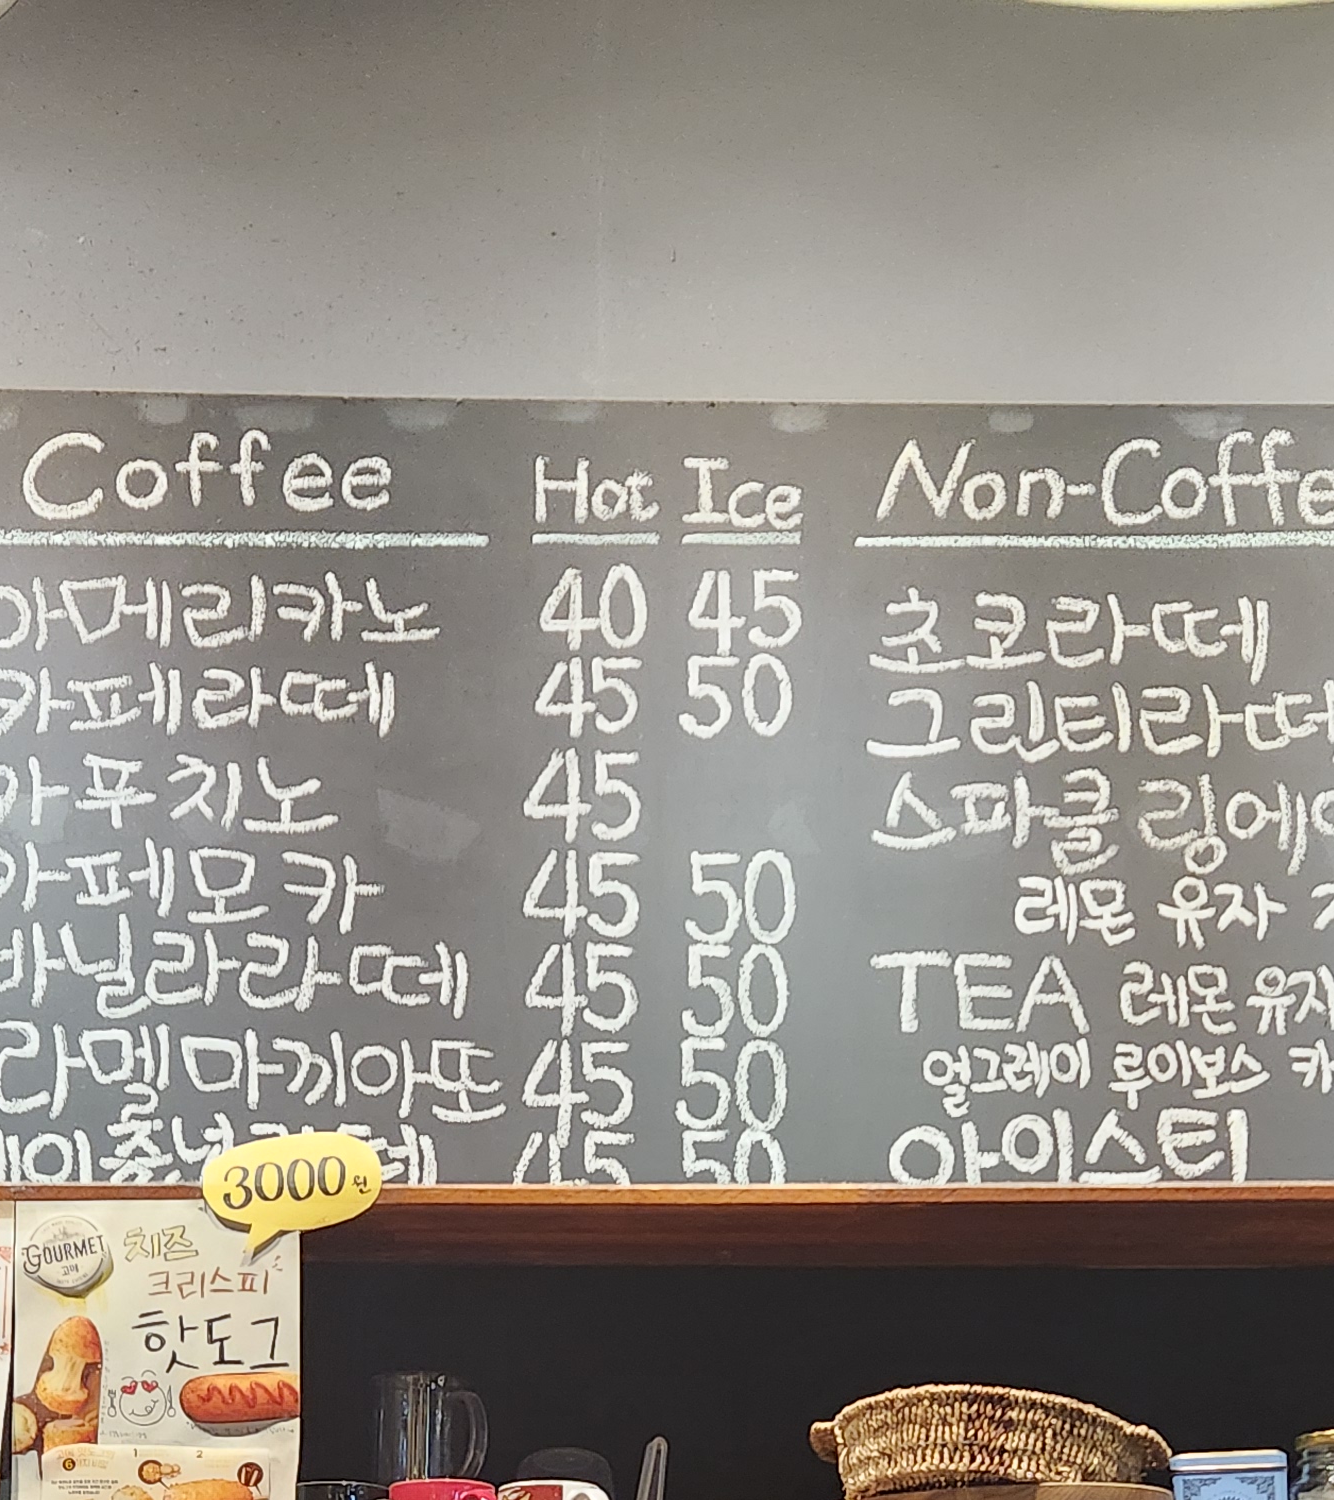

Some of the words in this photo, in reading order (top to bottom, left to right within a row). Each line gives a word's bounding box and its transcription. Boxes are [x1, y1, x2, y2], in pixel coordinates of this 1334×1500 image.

[22, 430, 392, 520] Coffee
[535, 455, 660, 524] Hot
[682, 457, 803, 530] Ice
[539, 562, 649, 650] 40
[687, 569, 803, 656] 45
[869, 587, 1270, 686] 초코라떼
[535, 656, 643, 739] 45
[678, 653, 793, 739] 50
[523, 747, 641, 843] 45
[522, 849, 642, 938] 45
[685, 849, 796, 944] 50
[1013, 875, 1136, 947] 레몬
[1157, 875, 1288, 950] 유자
[525, 942, 639, 1036] 45
[682, 943, 790, 1037] 50
[869, 949, 1091, 1035] TEA
[1120, 961, 1237, 1035] 레몬
[522, 1038, 634, 1148] 45
[675, 1038, 788, 1132] 50
[923, 1037, 1092, 1119] 얼그레이
[1109, 1040, 1271, 1112] 루이보스
[513, 1131, 635, 1186] 45
[682, 1129, 786, 1186] 50
[888, 1107, 1250, 1186] 아이스티
[21, 1234, 106, 1275] GOURMET
[124, 1225, 199, 1262] 치즈
[148, 1266, 269, 1299] 크리스피
[131, 1310, 290, 1374] 핫도그
